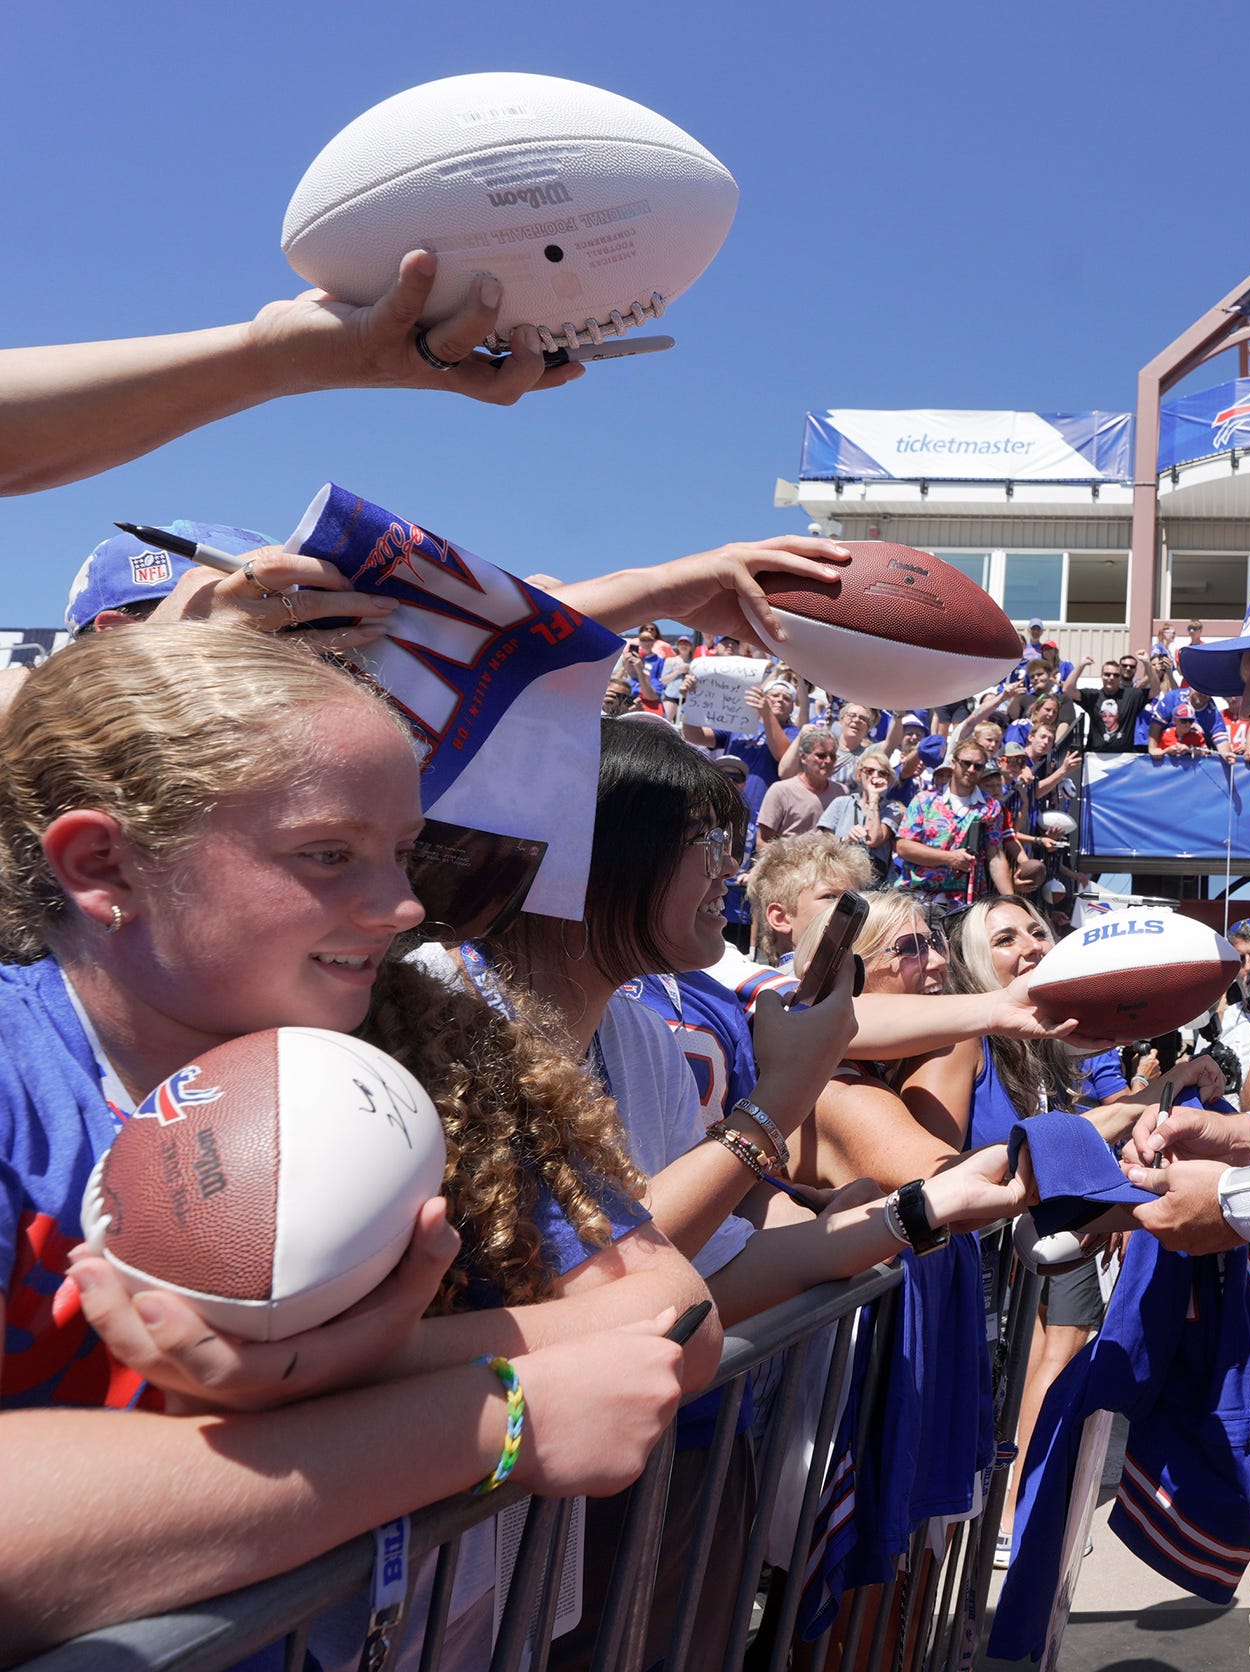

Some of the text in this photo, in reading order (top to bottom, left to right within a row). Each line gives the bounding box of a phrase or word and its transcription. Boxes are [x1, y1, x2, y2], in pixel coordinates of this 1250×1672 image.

[487, 183, 573, 208] Wilson
[493, 218, 577, 245] FOOTBALL
[896, 434, 1036, 455] ticketmaster
[138, 566, 166, 582] NFL
[488, 638, 520, 672] JOSH
[469, 671, 493, 718] ALLEN
[1082, 920, 1164, 946] BILLS
[194, 1127, 227, 1198] Wilson
